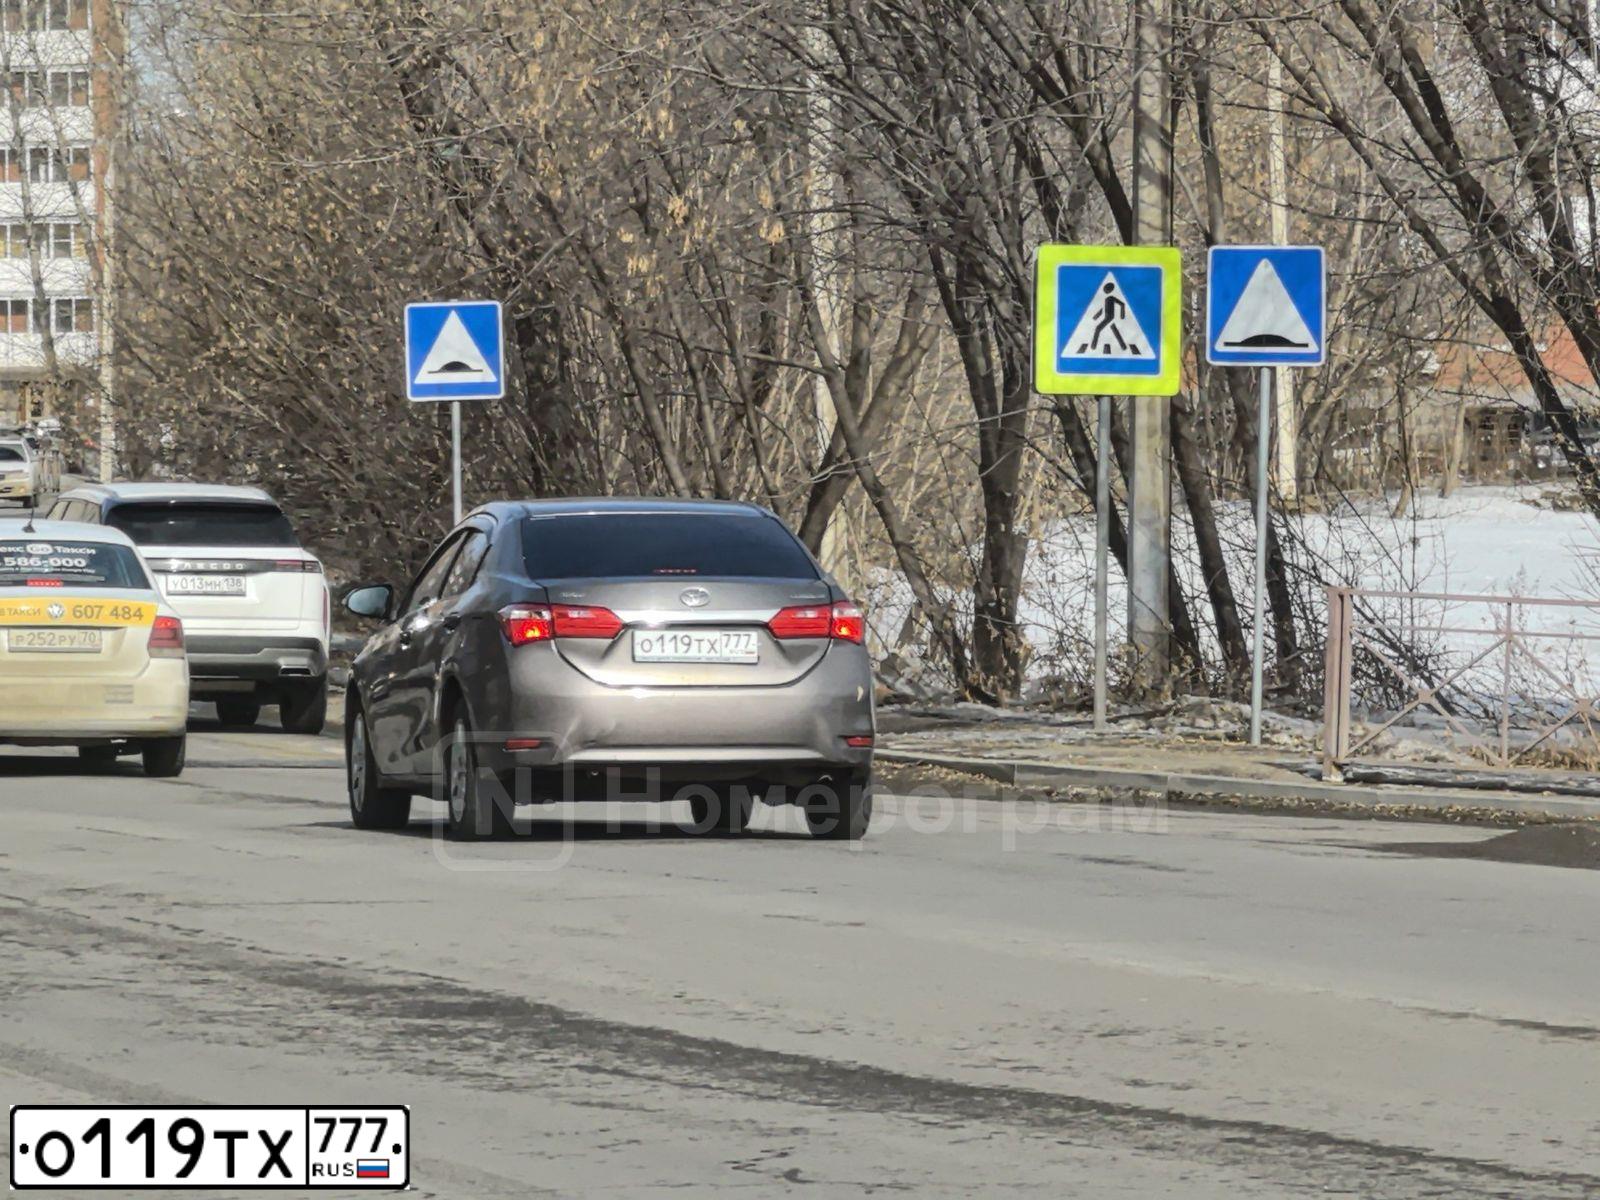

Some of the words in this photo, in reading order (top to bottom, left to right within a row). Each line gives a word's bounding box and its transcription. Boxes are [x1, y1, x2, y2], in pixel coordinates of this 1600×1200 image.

[54, 545, 96, 555] Такси
[172, 577, 221, 590] У013МН
[224, 577, 242, 588] 138
[7, 607, 41, 617] ТАКСИ
[72, 604, 104, 619] 607
[109, 605, 144, 621] 484
[15, 632, 77, 646] Р252РУ
[82, 631, 96, 643] 70
[640, 634, 718, 654] О119ТХ
[722, 633, 752, 648] 777
